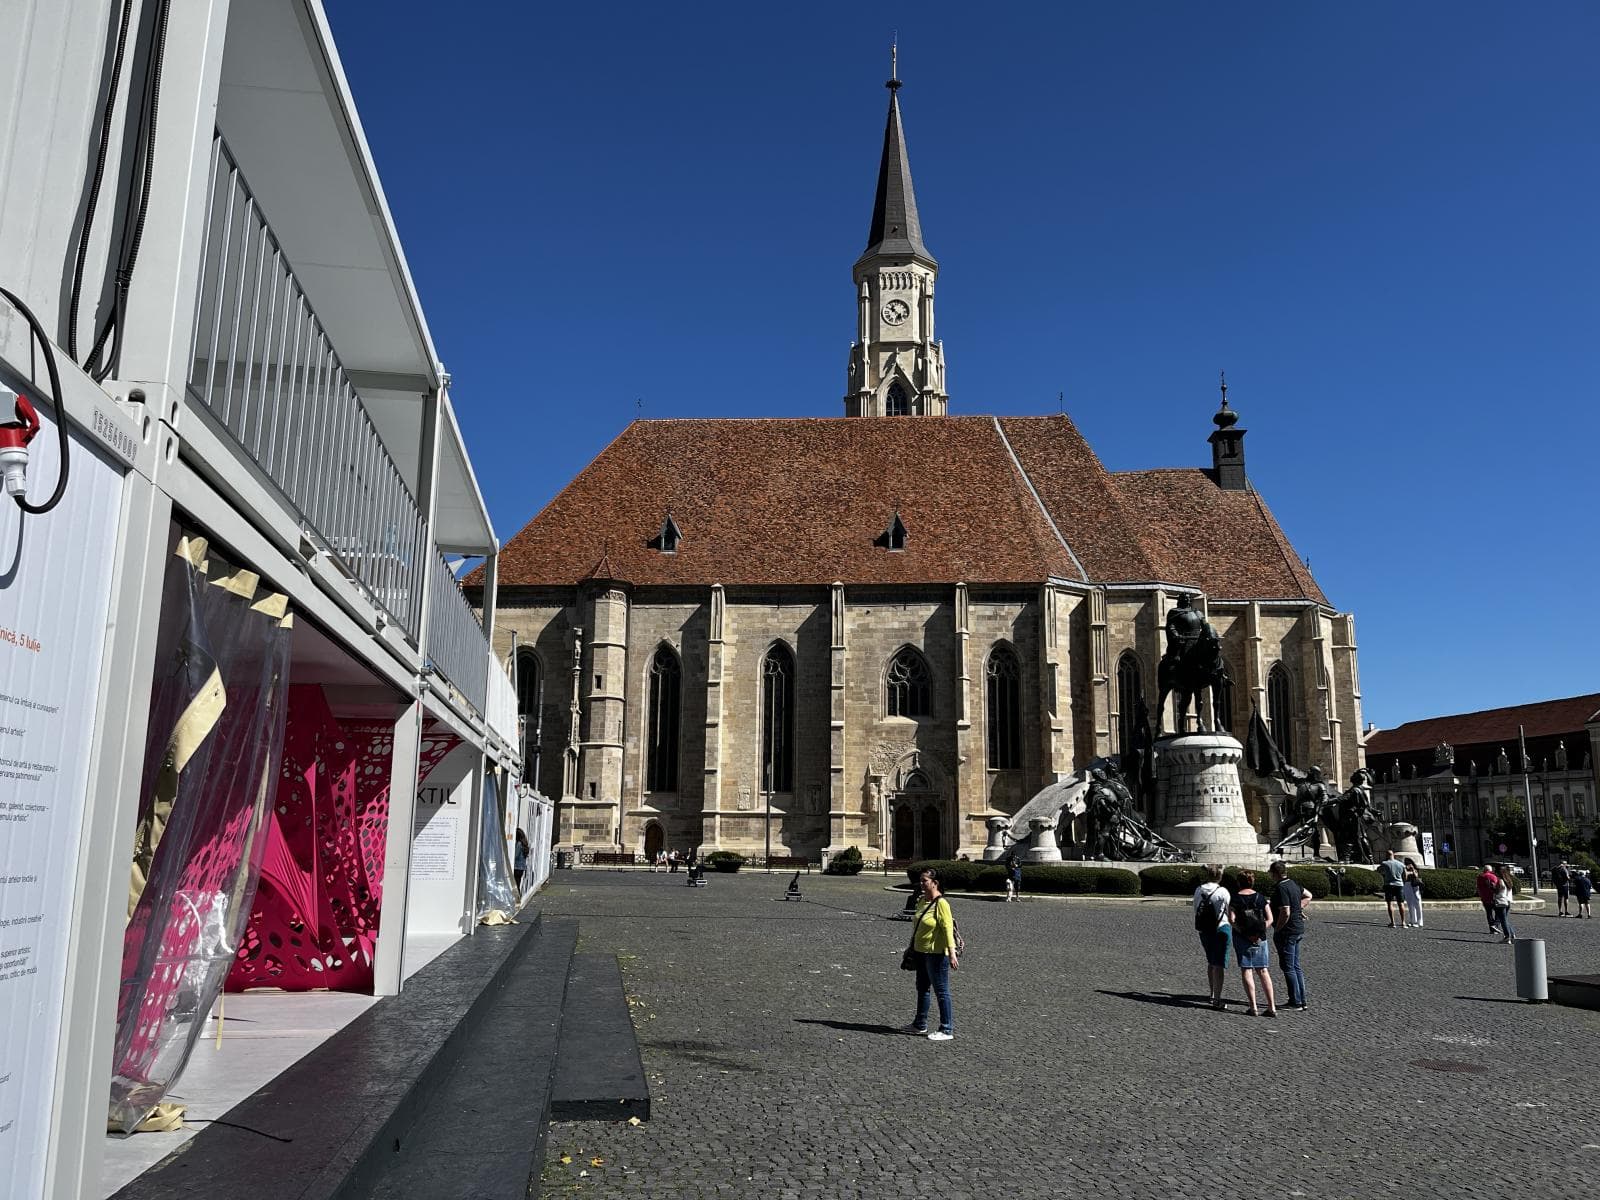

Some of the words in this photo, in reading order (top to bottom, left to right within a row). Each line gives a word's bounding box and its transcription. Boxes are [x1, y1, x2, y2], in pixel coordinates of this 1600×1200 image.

[0, 627, 17, 646] nică,
[19, 633, 25, 647] 5
[26, 635, 41, 652] Iulie
